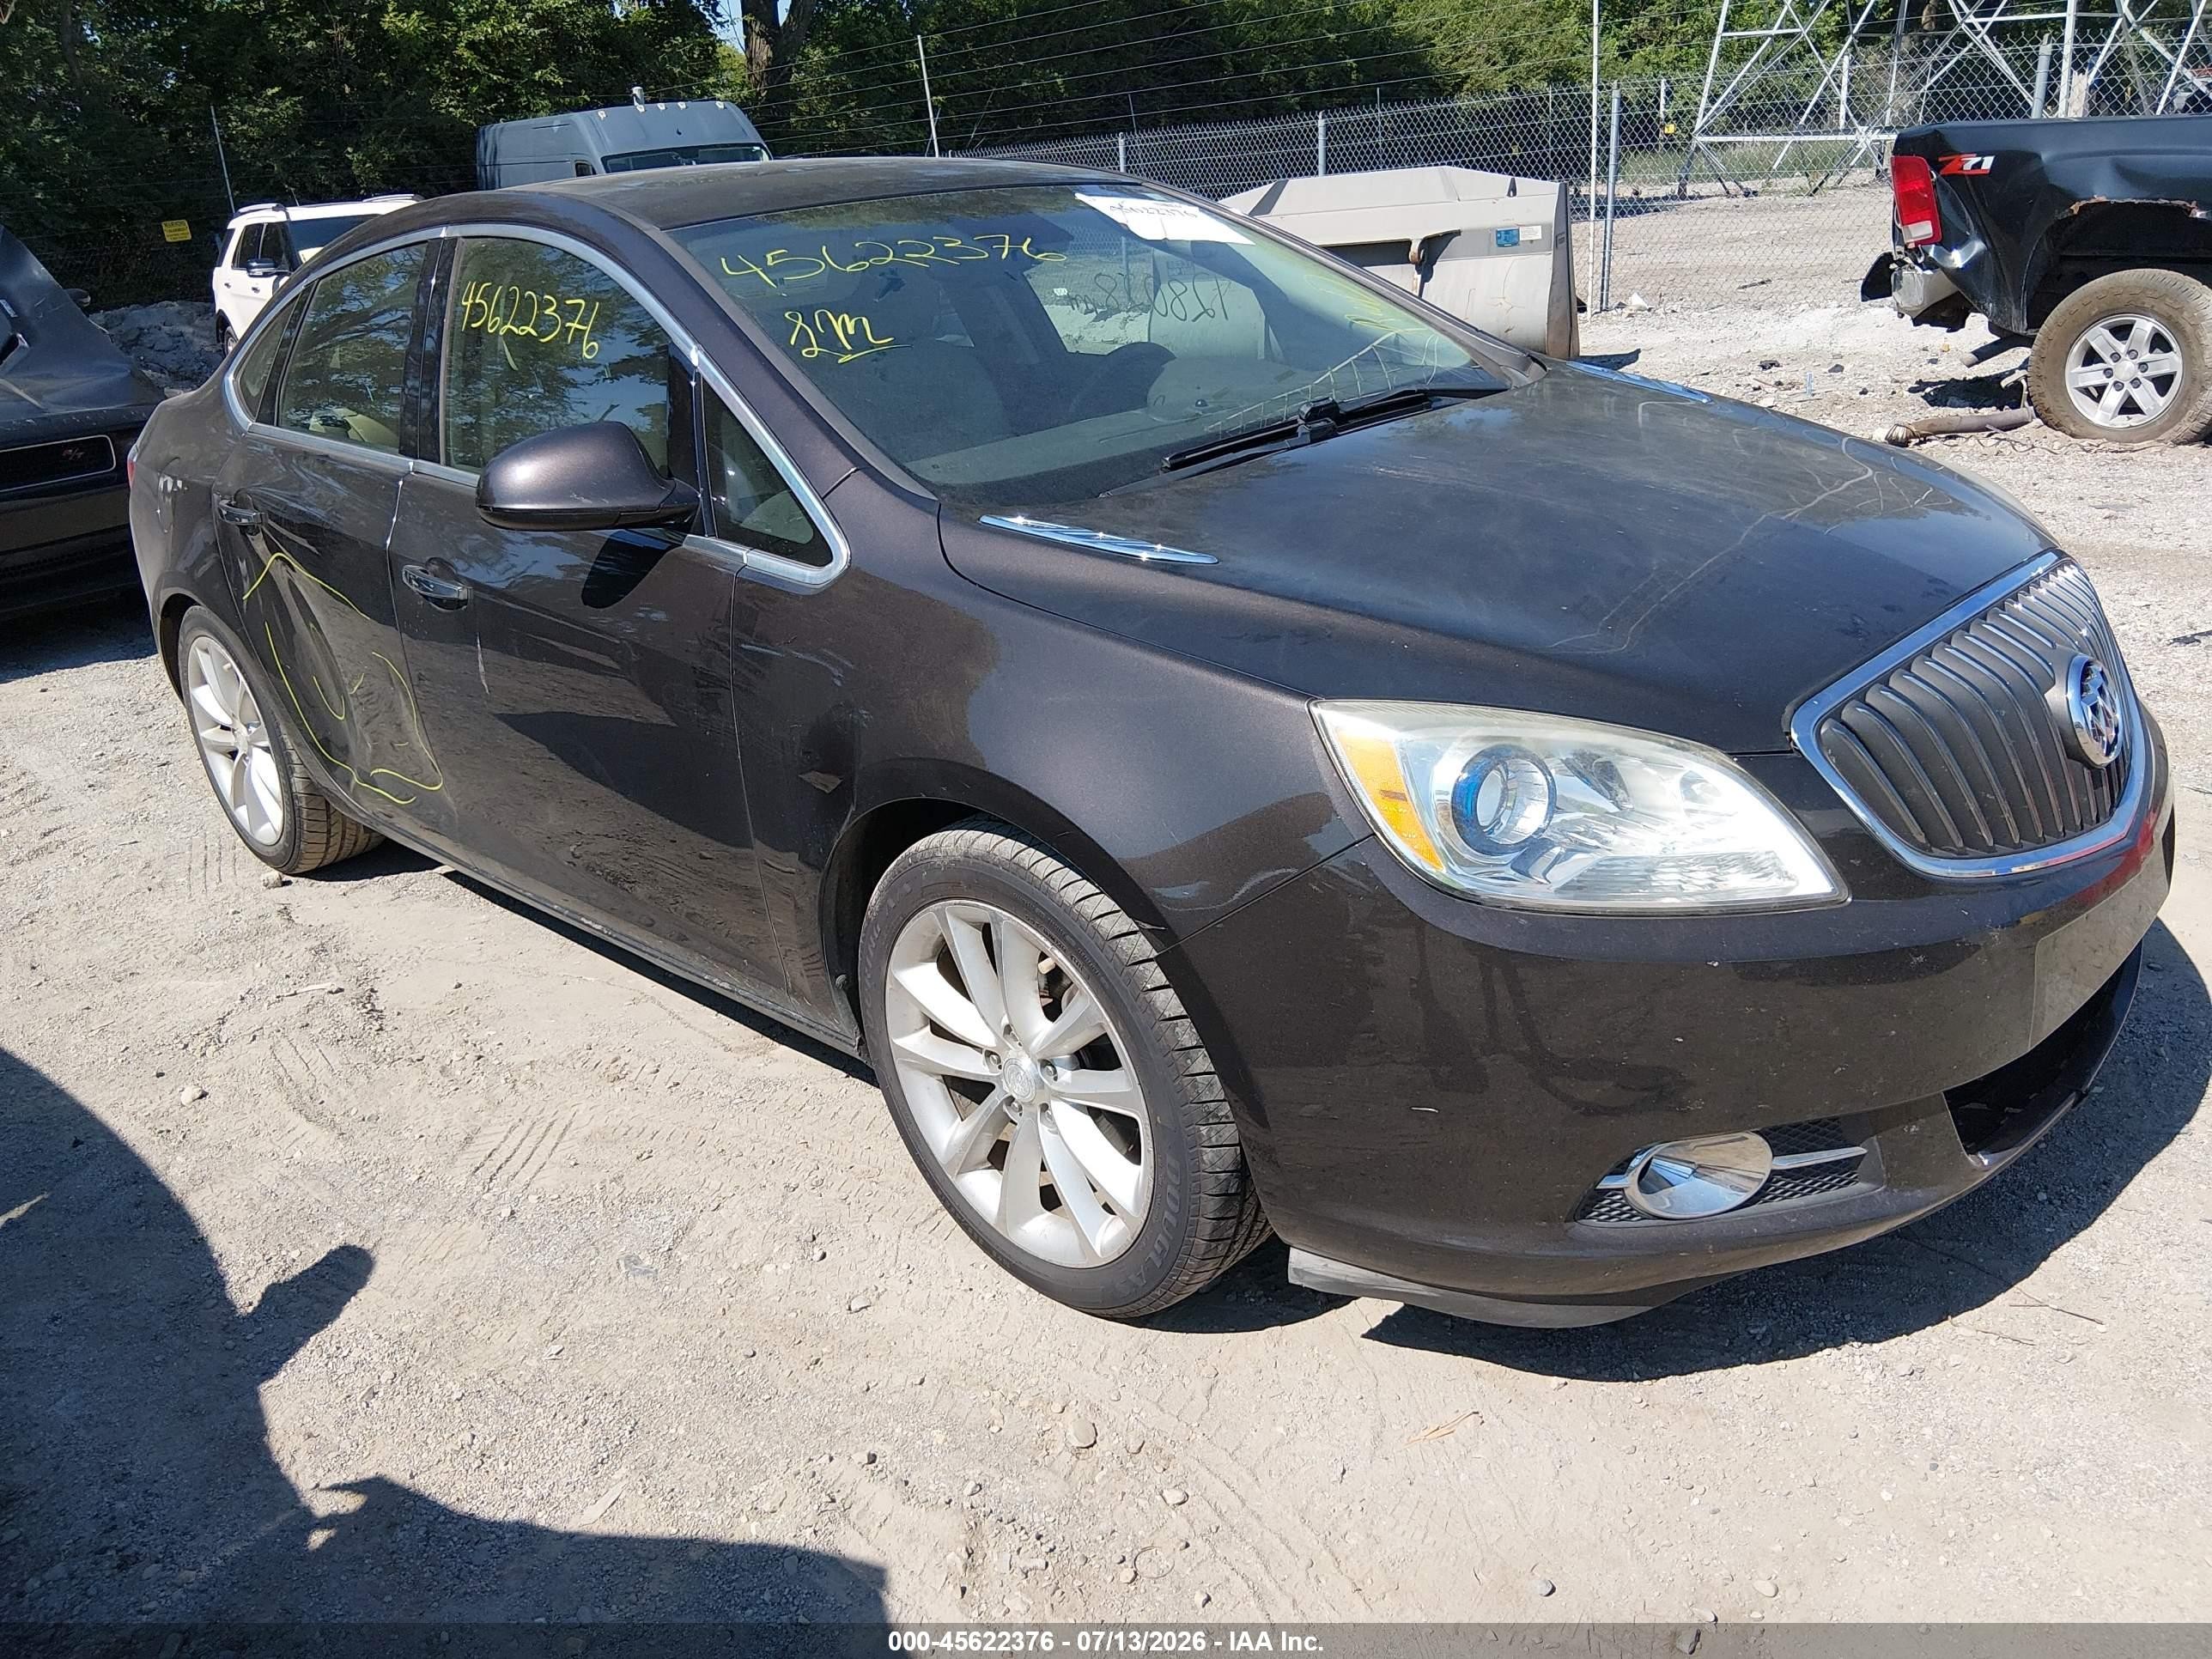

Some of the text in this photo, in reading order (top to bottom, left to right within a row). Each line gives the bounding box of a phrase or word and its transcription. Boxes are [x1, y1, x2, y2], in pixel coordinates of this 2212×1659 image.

[1938, 154, 1996, 175] Z71
[720, 234, 1067, 289] 45622376
[461, 281, 599, 360] 45622376
